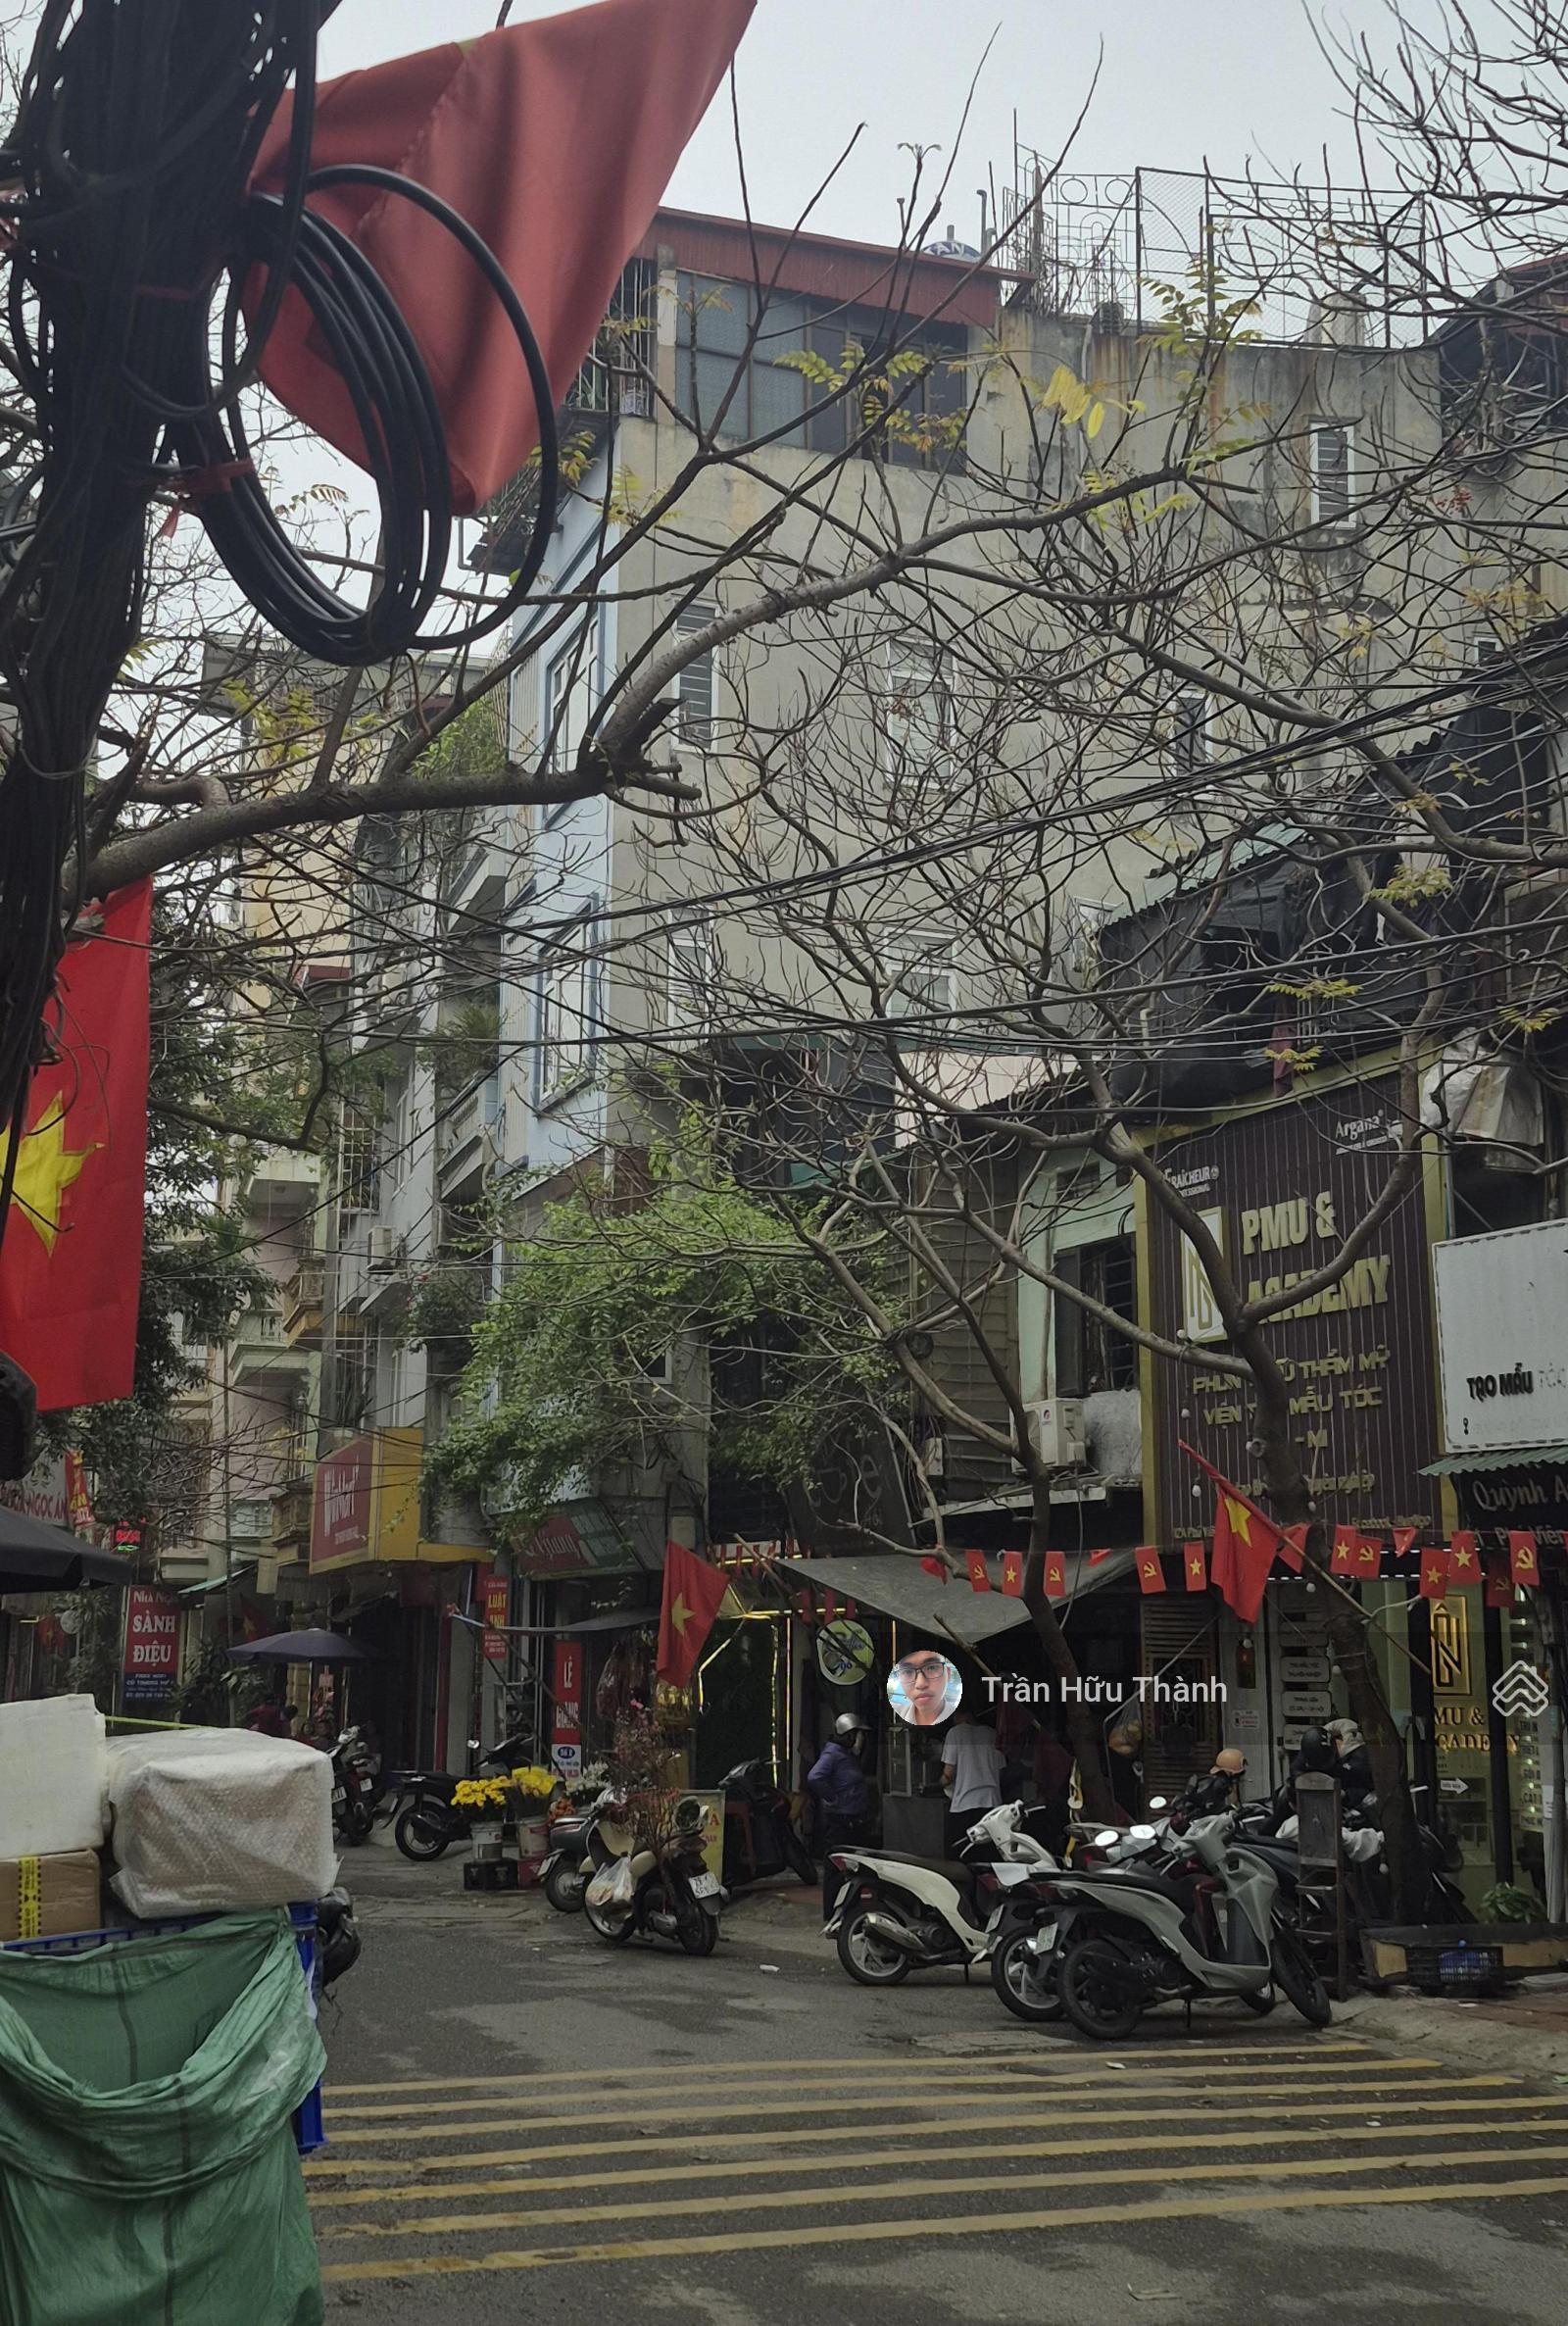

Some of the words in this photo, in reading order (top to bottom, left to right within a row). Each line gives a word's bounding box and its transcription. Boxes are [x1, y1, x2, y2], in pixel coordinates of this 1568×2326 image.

[1241, 1197, 1309, 1256] PMU
[1315, 1190, 1337, 1239] &
[1339, 1383, 1384, 1410] TÓC
[1473, 1477, 1548, 1512] Quỳnh
[132, 1639, 172, 1667] ĐIỆU
[1435, 1707, 1464, 1726] MU
